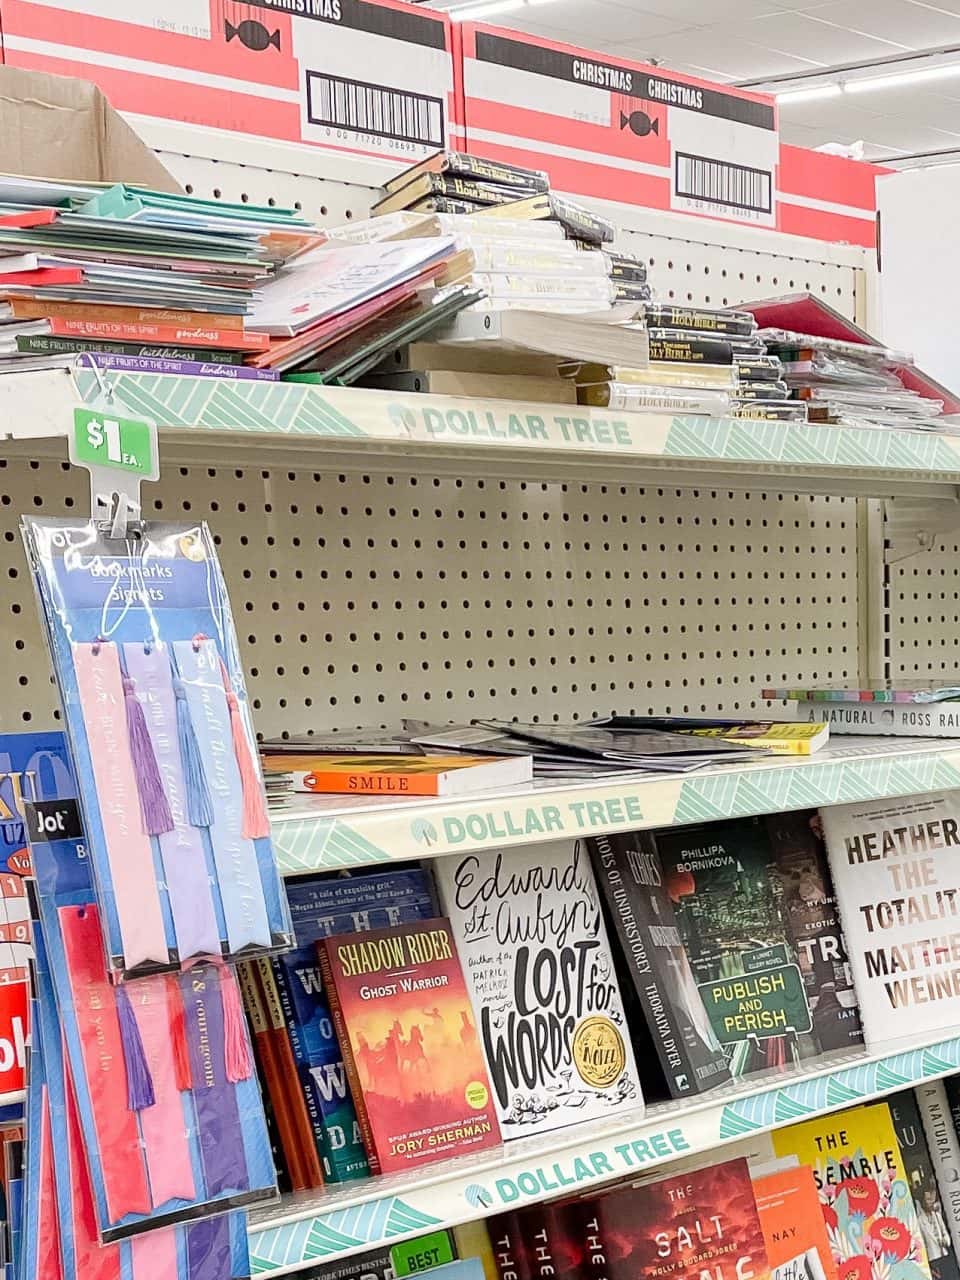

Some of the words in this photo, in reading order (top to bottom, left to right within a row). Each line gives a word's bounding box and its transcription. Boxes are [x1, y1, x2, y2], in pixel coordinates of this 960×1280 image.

[573, 60, 632, 92] CHRISTMAS
[648, 78, 703, 109] CHRISTMAS
[123, 324, 138, 334] THE
[29, 340, 49, 350] NINE
[50, 341, 75, 351] FRUITS
[77, 343, 88, 352] OF
[116, 357, 139, 368] FRUITS
[140, 360, 149, 369] OF
[200, 364, 238, 377] kindness
[87, 419, 122, 462] $1
[422, 407, 549, 441] DOLLAR
[557, 413, 633, 445] TREE
[808, 708, 816, 722] A
[822, 709, 875, 724] NATURAL
[902, 712, 932, 727] ROSS
[348, 776, 409, 791] SMILE
[37, 812, 65, 833] Jot
[442, 806, 562, 845] DOLLAR
[570, 796, 643, 827] TREE
[676, 856, 735, 873] BORNIKOVA
[681, 845, 726, 860] PHILLIPA
[455, 840, 582, 910] Edward
[607, 870, 623, 891] OF
[887, 859, 937, 891] THE
[613, 891, 652, 976] UNDERSTOREY
[338, 947, 404, 977] SHADOW
[408, 930, 452, 962] RIDER
[360, 983, 397, 1001] GHOST
[400, 975, 449, 992] WARRIOR
[514, 940, 600, 1018] LOST
[585, 963, 616, 1012] for
[712, 974, 785, 1004] PUBLISH
[644, 983, 672, 1037] THORAIYA
[724, 1009, 787, 1033] PERISH
[738, 999, 762, 1013] AND
[288, 1019, 303, 1059] WORLD
[304, 1085, 318, 1118] DAVID
[481, 1006, 574, 1109] WORDS
[663, 1037, 682, 1069] DYER
[390, 1140, 423, 1156] JORY
[428, 1122, 492, 1146] SHERMAN
[815, 1130, 849, 1152] THE
[927, 1103, 955, 1163] NATURAL
[495, 1153, 613, 1203] DOLLAR
[616, 1129, 690, 1166] TREE
[668, 1185, 693, 1202] THE
[534, 1229, 554, 1276] THE
[586, 1217, 605, 1265] THE
[655, 1215, 725, 1257] SALT
[338, 1265, 361, 1279] TIMES
[408, 1248, 439, 1271] BEST
[497, 1235, 518, 1280] THE
